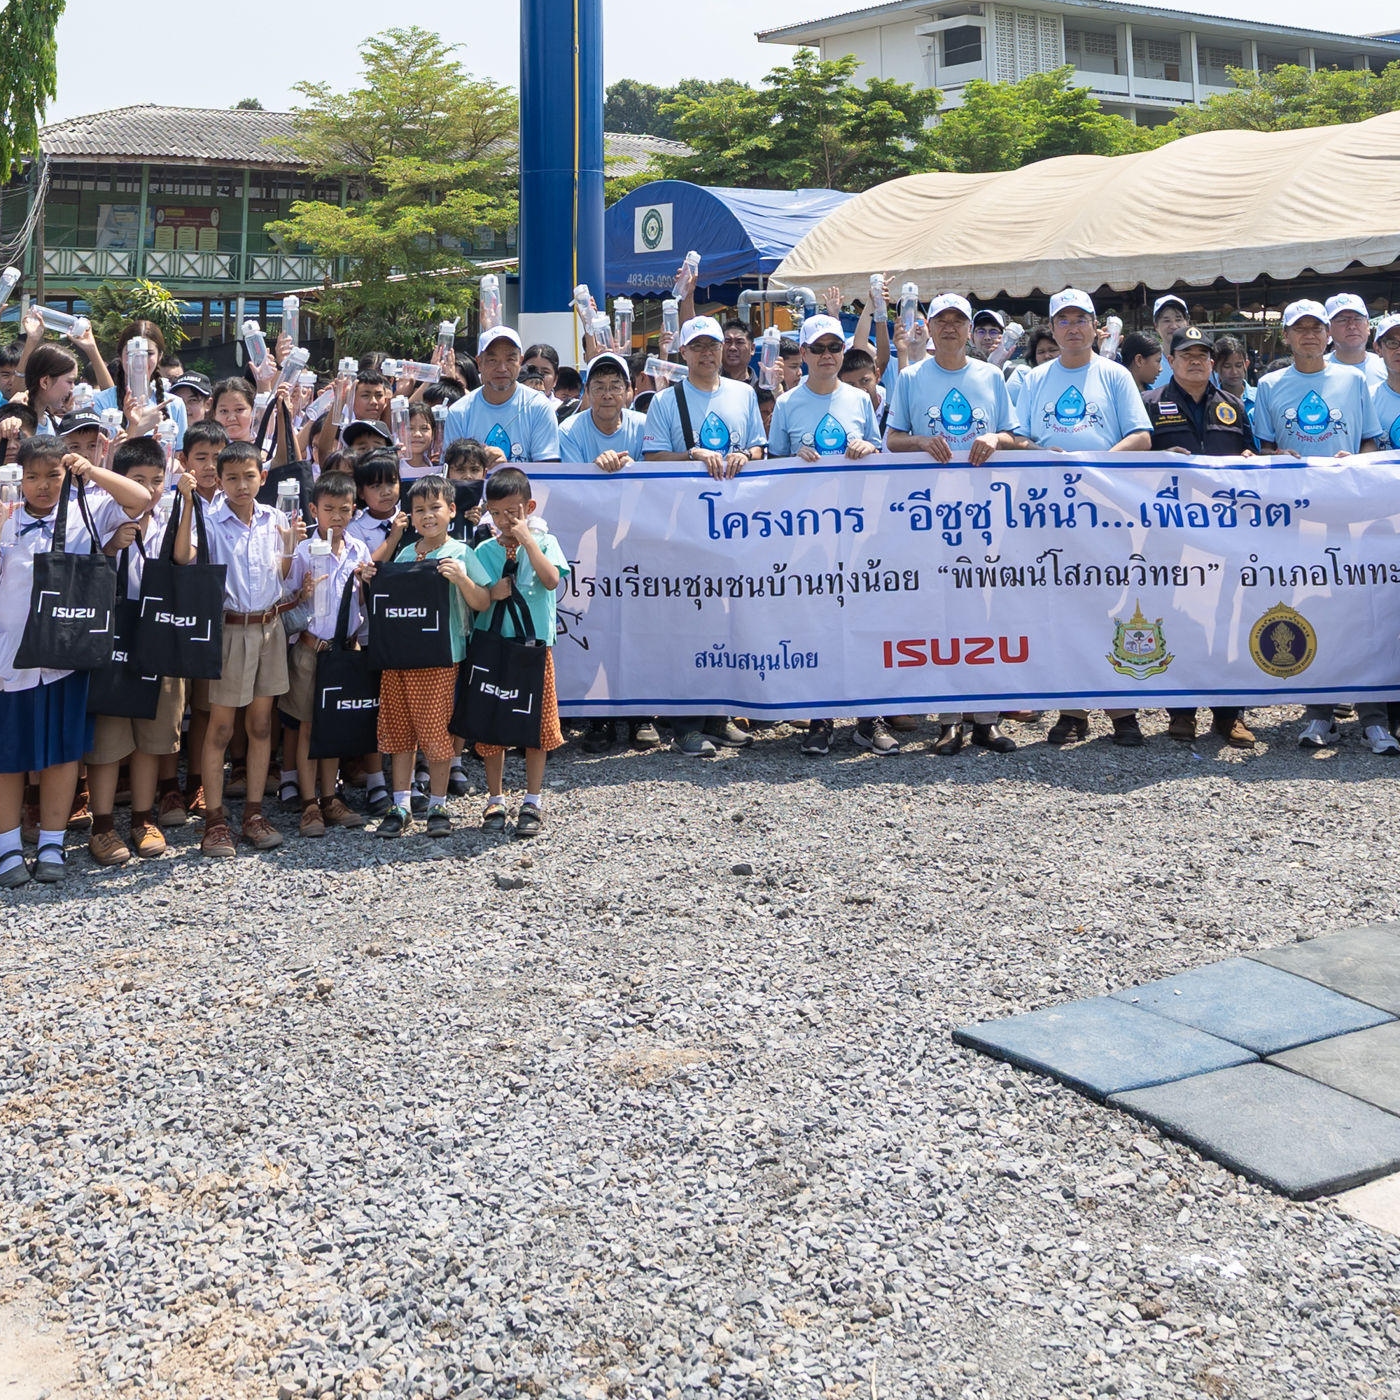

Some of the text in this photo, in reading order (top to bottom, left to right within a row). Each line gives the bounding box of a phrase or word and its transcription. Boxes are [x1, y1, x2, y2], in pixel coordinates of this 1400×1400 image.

[698, 491, 865, 540] โครงการ
[568, 557, 920, 611] โรงเรียนชุมชนบ้านทุ่งน้อย
[938, 549, 1220, 589] “พิพัฒน์โสภณวิทยา”
[52, 606, 96, 619] ISUZU
[385, 607, 427, 618] ISUZU
[694, 640, 819, 682] สนับสนุนโดย
[882, 636, 1030, 669] ISUZU
[336, 697, 380, 710] ISUZU
